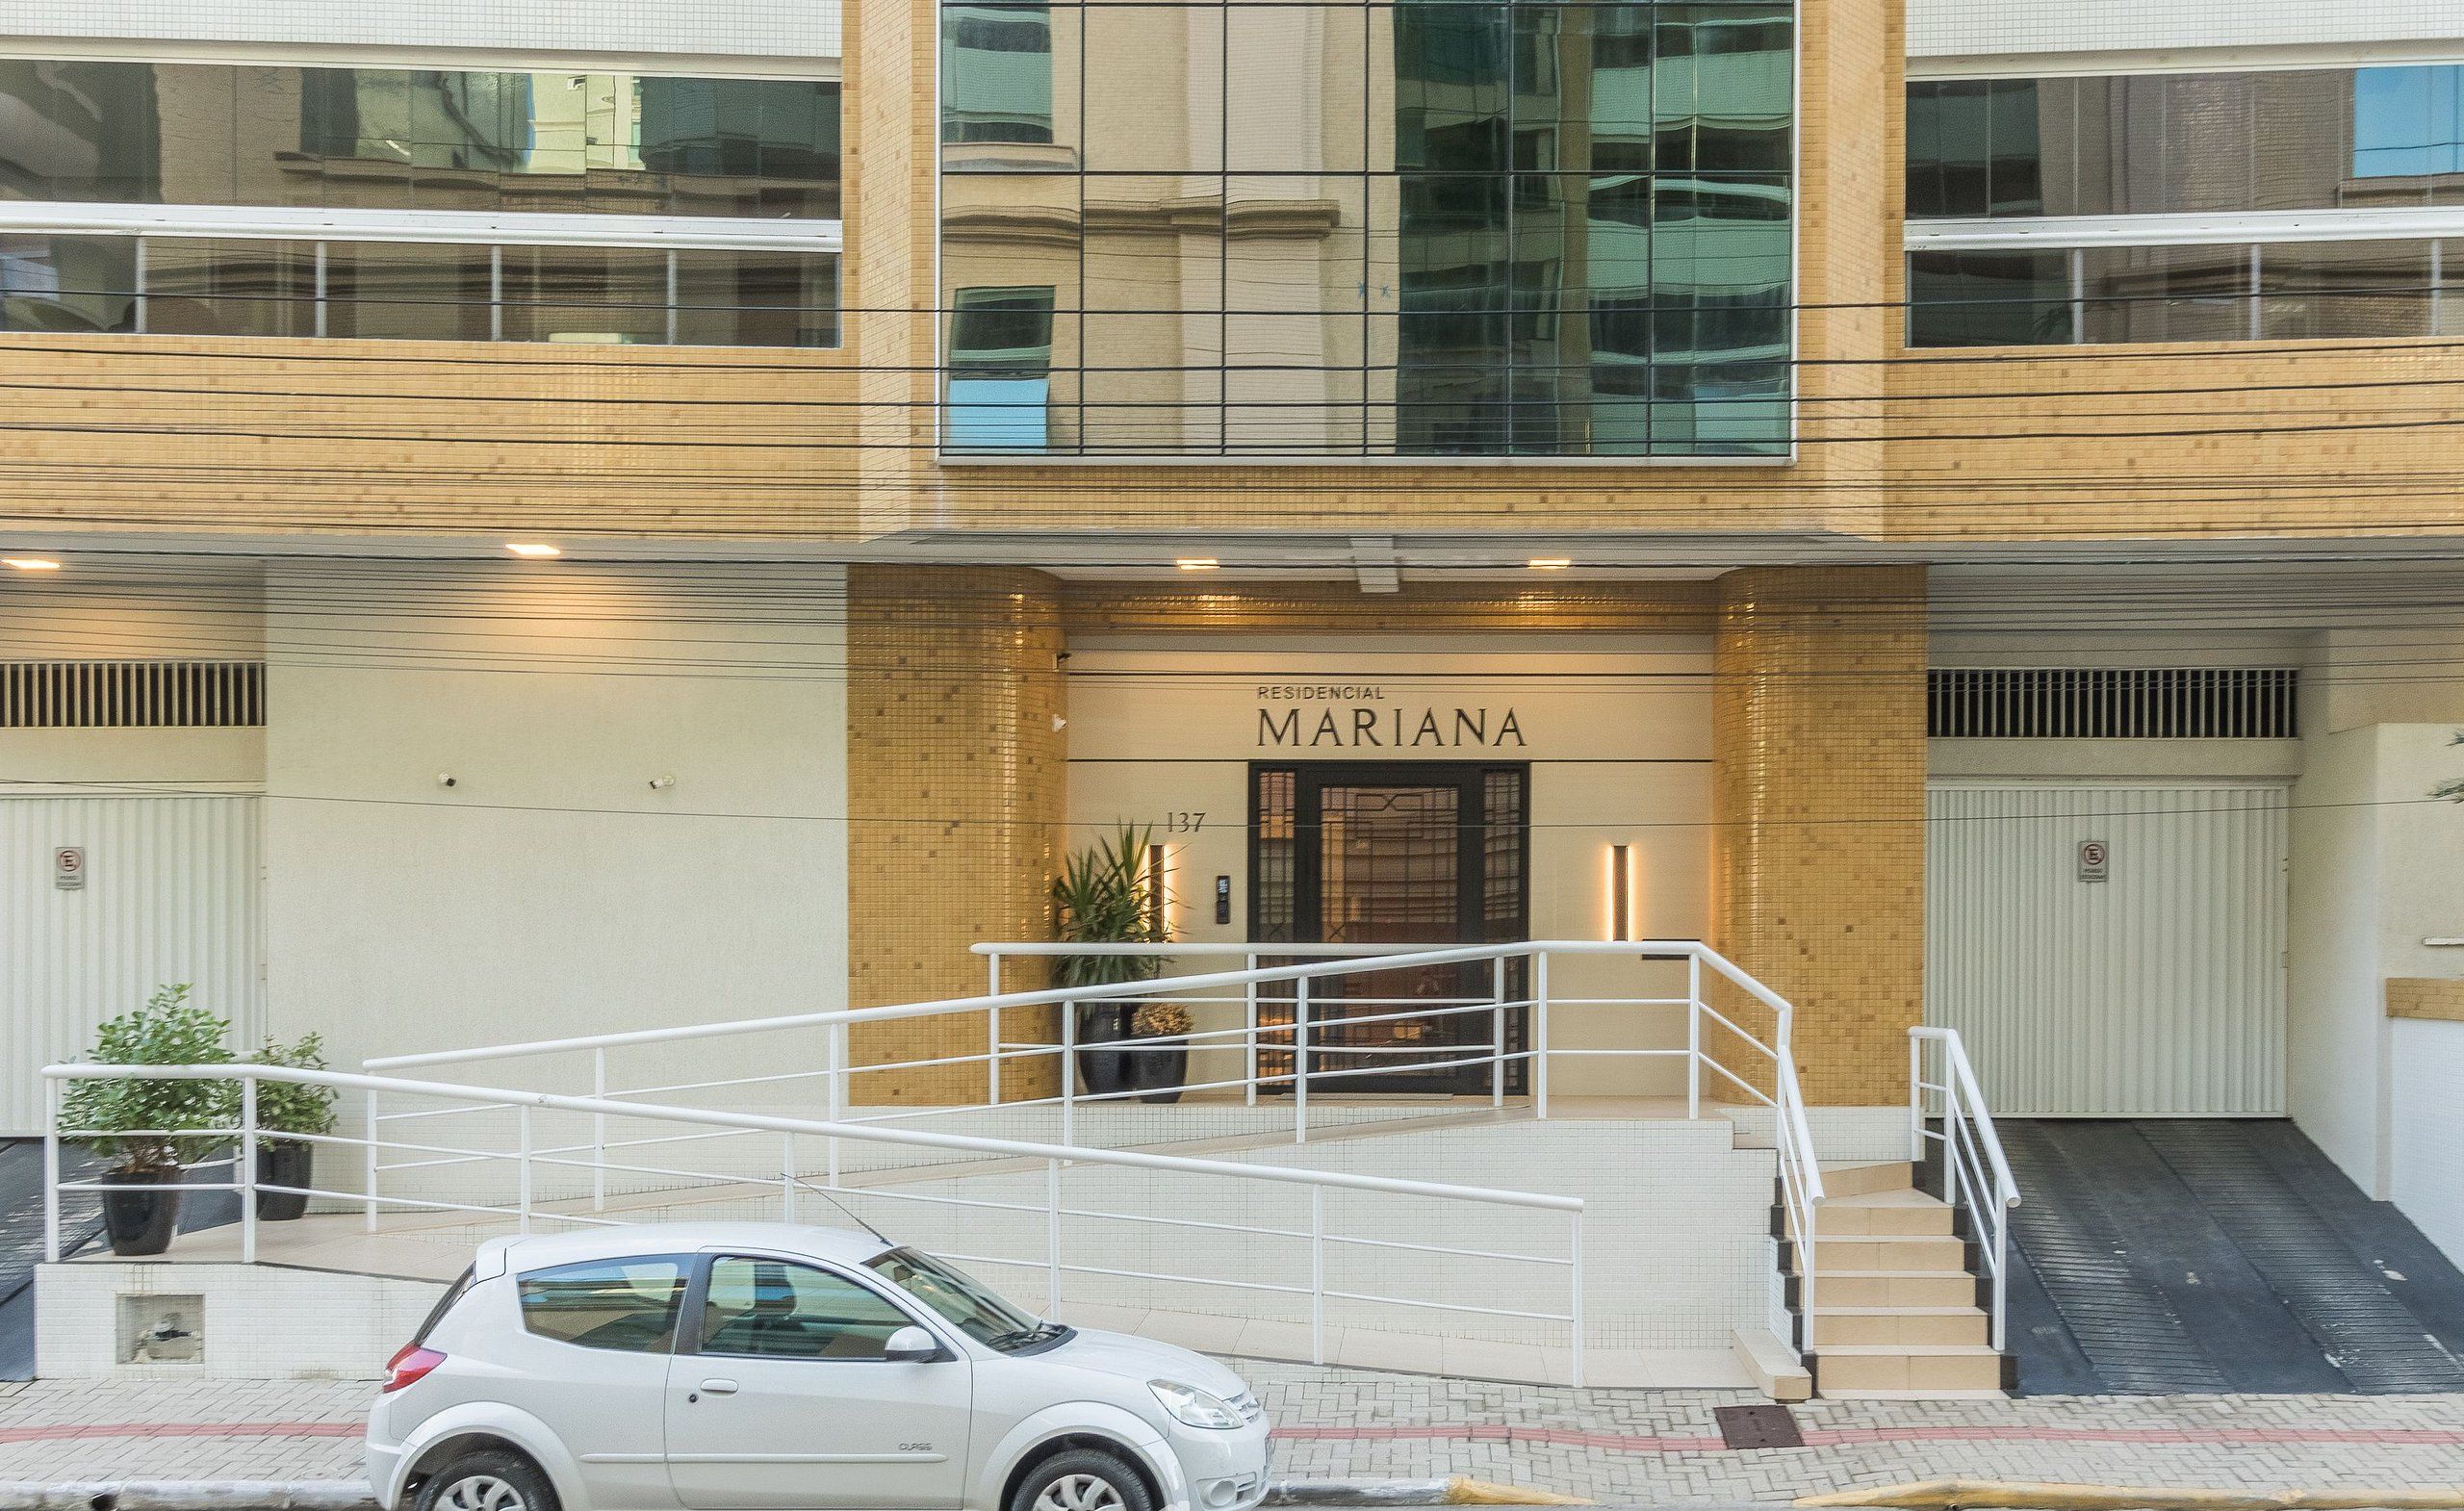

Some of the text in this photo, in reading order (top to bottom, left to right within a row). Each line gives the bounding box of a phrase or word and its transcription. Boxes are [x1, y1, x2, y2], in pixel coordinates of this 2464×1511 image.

[1257, 686, 1384, 700] RESIDENCIAL
[1257, 707, 1527, 747] MARIANA
[1167, 811, 1206, 832] 137
[898, 1442, 933, 1451] CLASS
